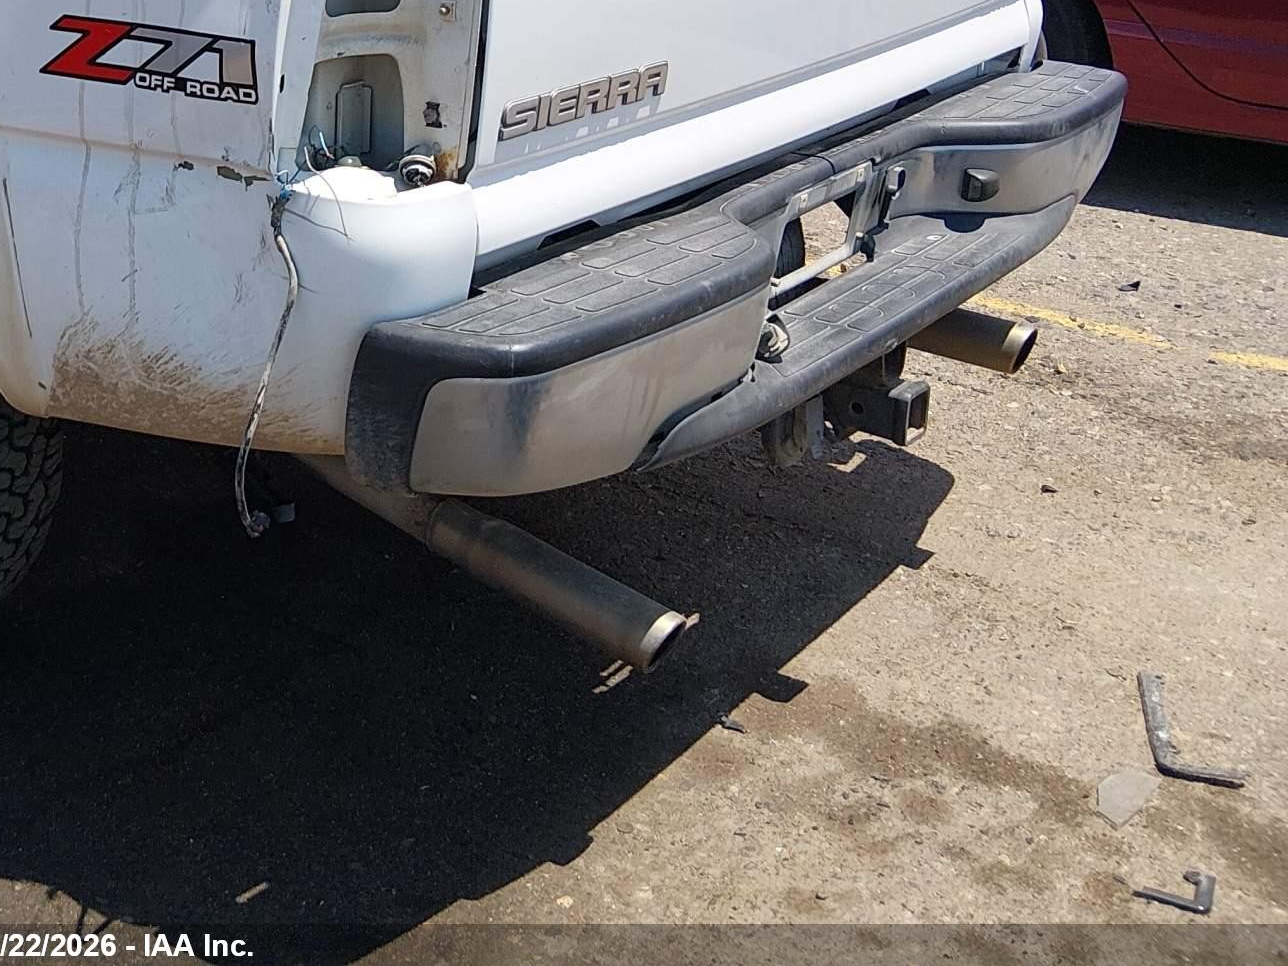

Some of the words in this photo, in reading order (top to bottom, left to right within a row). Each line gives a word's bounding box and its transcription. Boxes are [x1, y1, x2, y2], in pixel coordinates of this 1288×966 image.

[40, 15, 256, 86] Z71
[135, 72, 175, 91] OFF
[186, 80, 257, 103] ROAD
[499, 60, 669, 141] SIERRA
